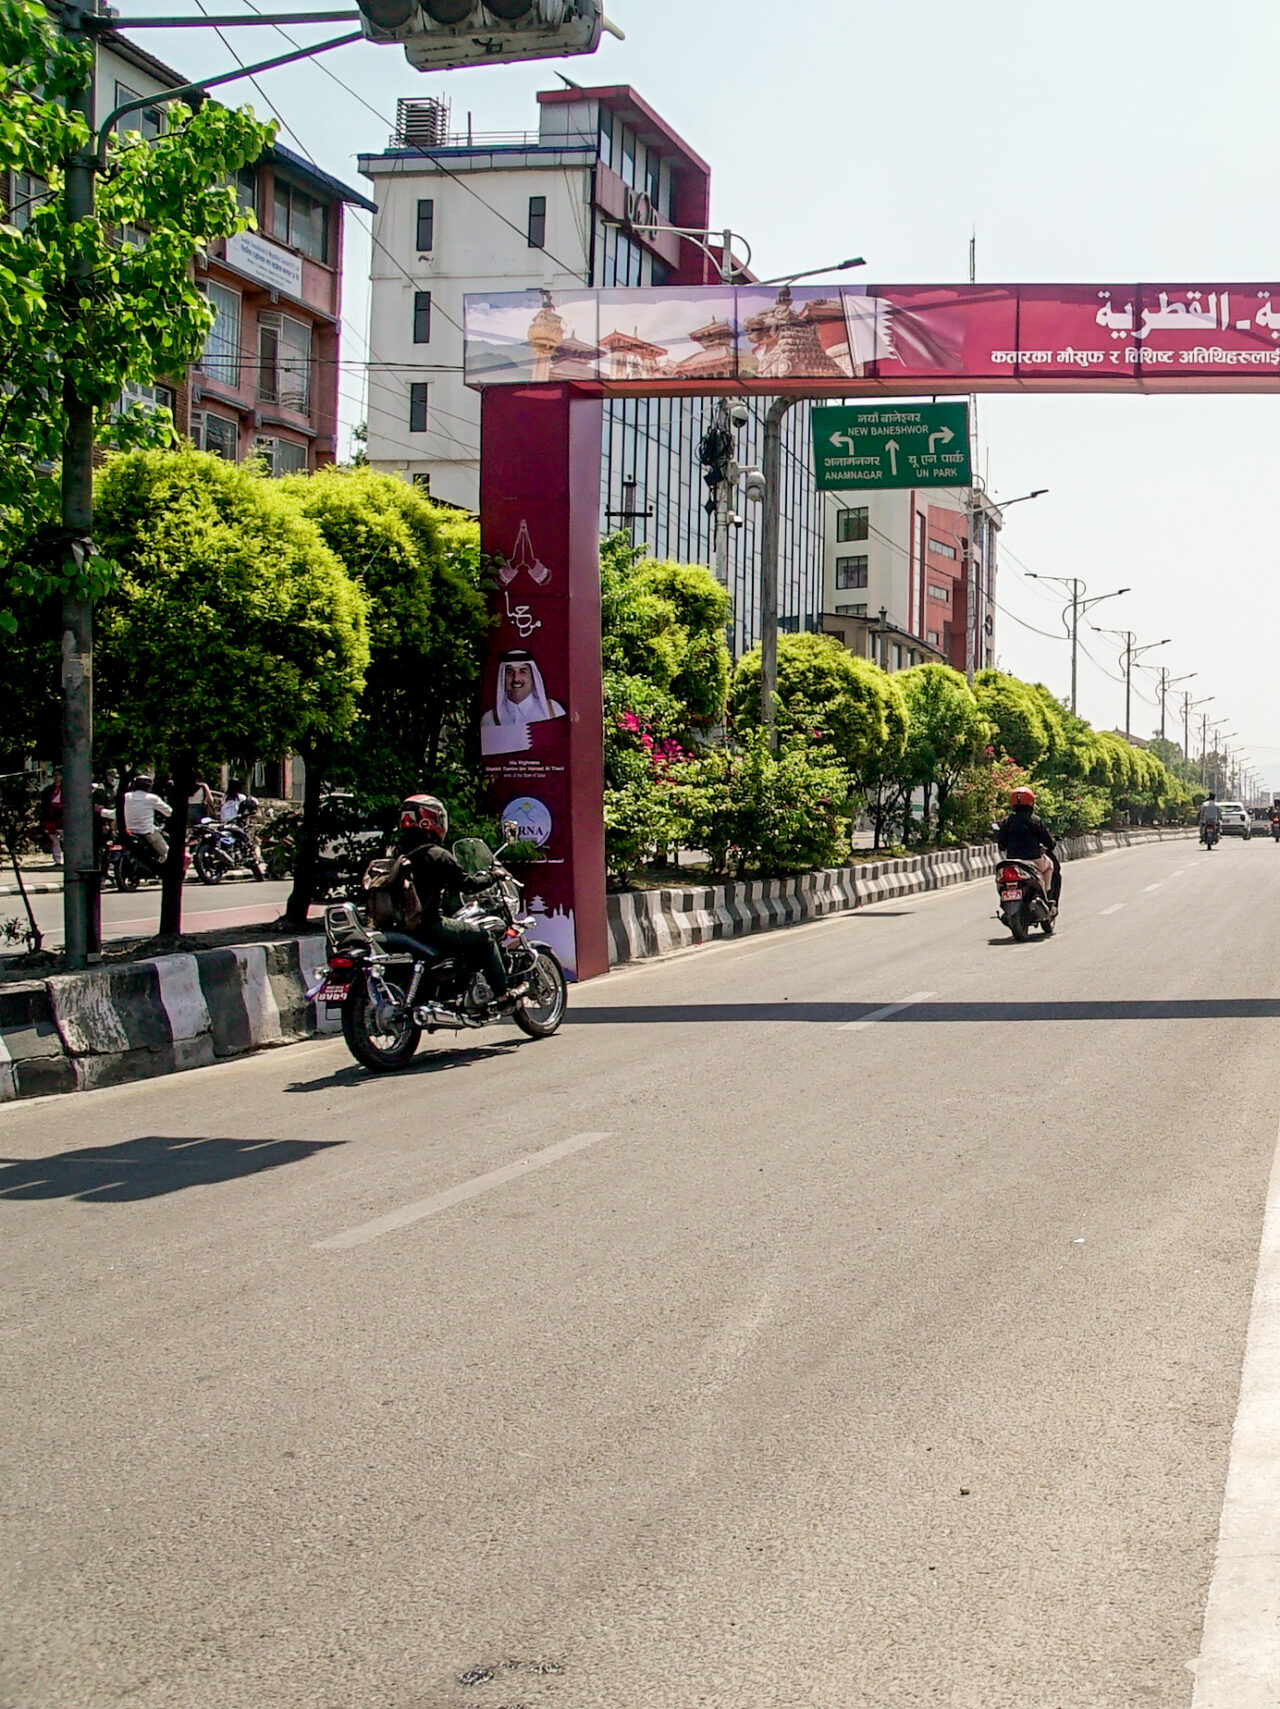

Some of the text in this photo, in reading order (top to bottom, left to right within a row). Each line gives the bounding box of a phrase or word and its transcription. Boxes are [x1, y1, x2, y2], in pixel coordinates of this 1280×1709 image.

[991, 350, 1053, 364] कतारका
[1056, 346, 1105, 367] मौसुफ
[1109, 350, 1120, 364] र
[1124, 347, 1174, 364] विशिष्ट
[848, 424, 929, 437] NEW BANESHWOR
[825, 470, 883, 480] ANAMNAGAR
[916, 467, 958, 478] UN PARK
[517, 826, 543, 836] RNA
